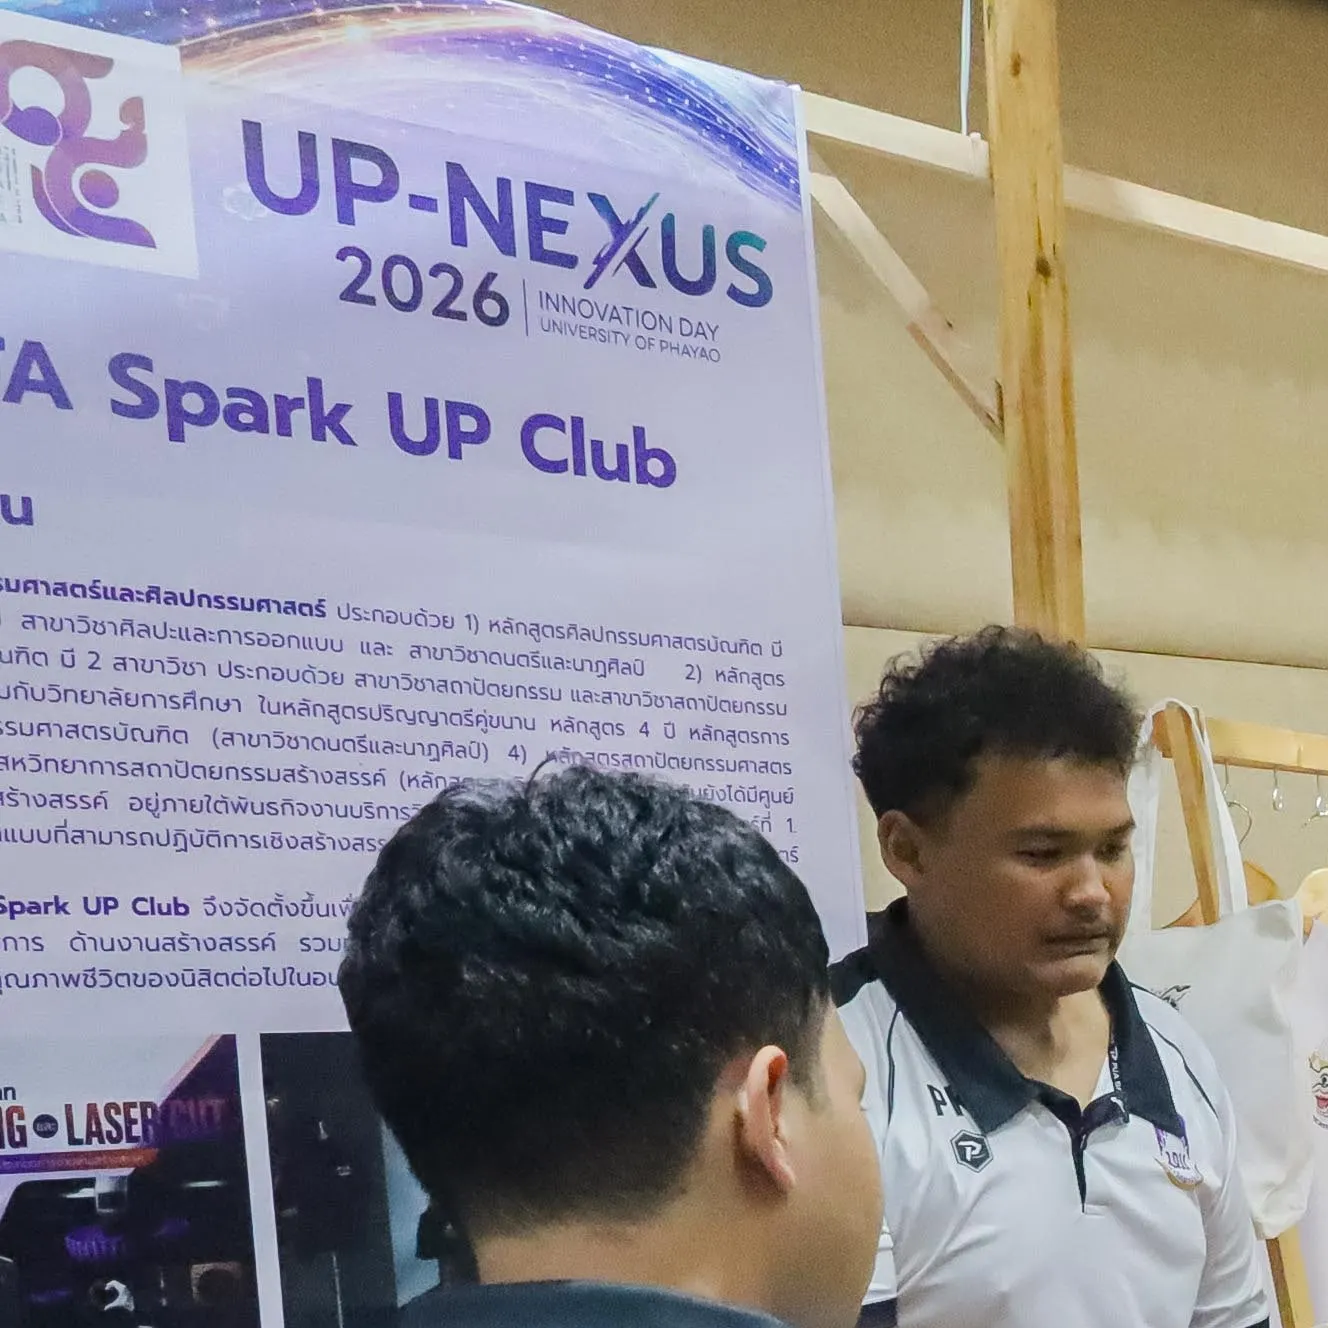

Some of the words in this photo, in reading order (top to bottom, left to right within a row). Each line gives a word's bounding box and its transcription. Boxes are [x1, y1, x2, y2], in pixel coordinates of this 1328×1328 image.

[241, 118, 774, 308] UP-NEXUS
[337, 245, 510, 328] 2026
[538, 290, 673, 334] INNOVATION
[679, 316, 719, 342] DAY
[540, 317, 630, 347] UNIVERSITY
[634, 334, 655, 352] OF
[659, 338, 721, 363] PHAYAO
[0, 337, 74, 410] A
[107, 353, 359, 448] Spark
[386, 391, 491, 462] UP
[520, 413, 677, 489] Club
[337, 603, 454, 629] ประกอบด้วย
[464, 614, 479, 635] 1)
[88, 651, 102, 670] 2
[113, 656, 206, 676] สาขาวิชา
[218, 660, 344, 685] ประกอบด้วย
[355, 673, 562, 701] สาขาวิชาสถาปัตยกรรม
[571, 689, 787, 716] และสาขาวิชาสถาปัตยกรรม
[361, 641, 393, 656] และ
[685, 664, 701, 684] 2)
[715, 666, 785, 690] หลักสูตร
[508, 744, 526, 765] 4)
[550, 716, 625, 740] หลักสูตร
[639, 721, 649, 737] 4
[664, 721, 675, 739] ปี
[690, 724, 789, 748] หลักสูตรการ
[82, 896, 119, 916] UP
[131, 896, 190, 916] Club
[70, 931, 276, 952] ด้านงานสร้างสรรค์
[64, 1101, 160, 1146] LASER
